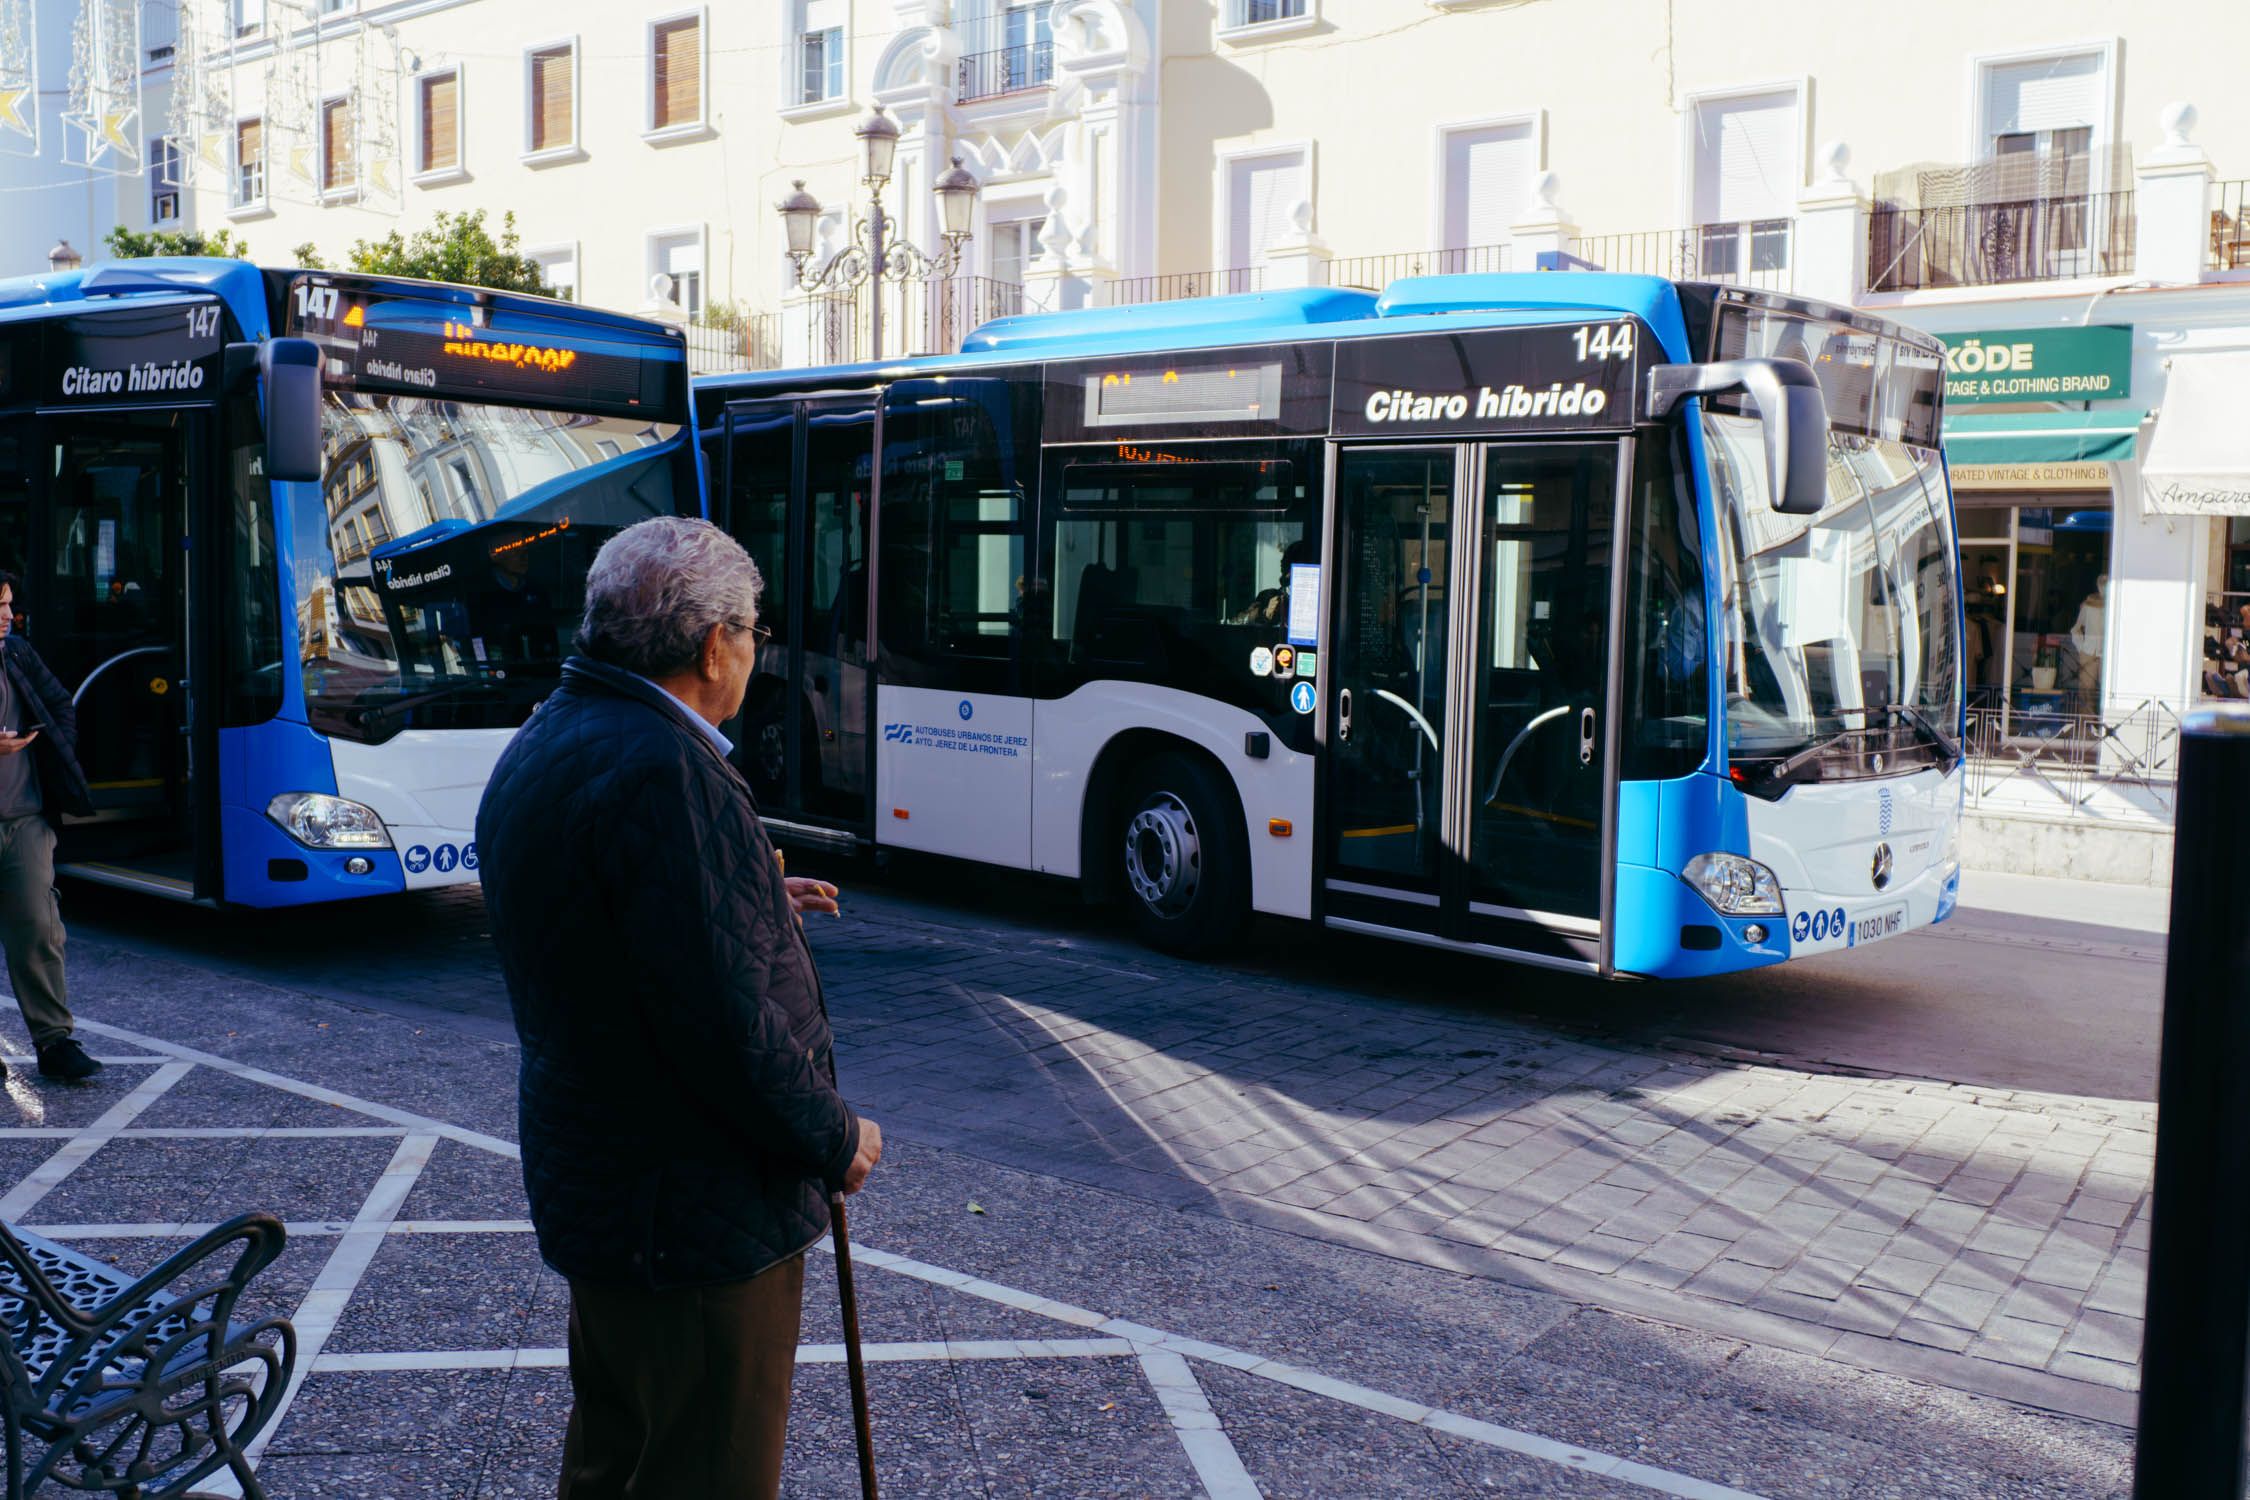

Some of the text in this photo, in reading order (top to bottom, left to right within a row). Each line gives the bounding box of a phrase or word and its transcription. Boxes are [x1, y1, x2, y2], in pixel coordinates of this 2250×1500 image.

[294, 284, 339, 319] 147
[186, 305, 221, 338] 147
[1572, 325, 1633, 362] 144
[62, 360, 204, 395] Citaro híbrido
[1980, 380, 1990, 395] &
[1993, 377, 2059, 394] CLOTHING
[2062, 375, 2110, 391] BRAND
[1365, 382, 1606, 423] Citaro híbrido
[1987, 468, 2030, 481] VINTAGE
[2033, 468, 2040, 480] &
[2043, 467, 2096, 480] CLOTHING
[915, 726, 1028, 747] AUTOBUSES URBANOS DE JEREZ
[935, 740, 957, 750] JEREZ
[958, 742, 968, 751] DE
[969, 744, 978, 752] LA
[979, 745, 1018, 758] FRONTERA
[1858, 910, 1902, 941] 1030 NHF
